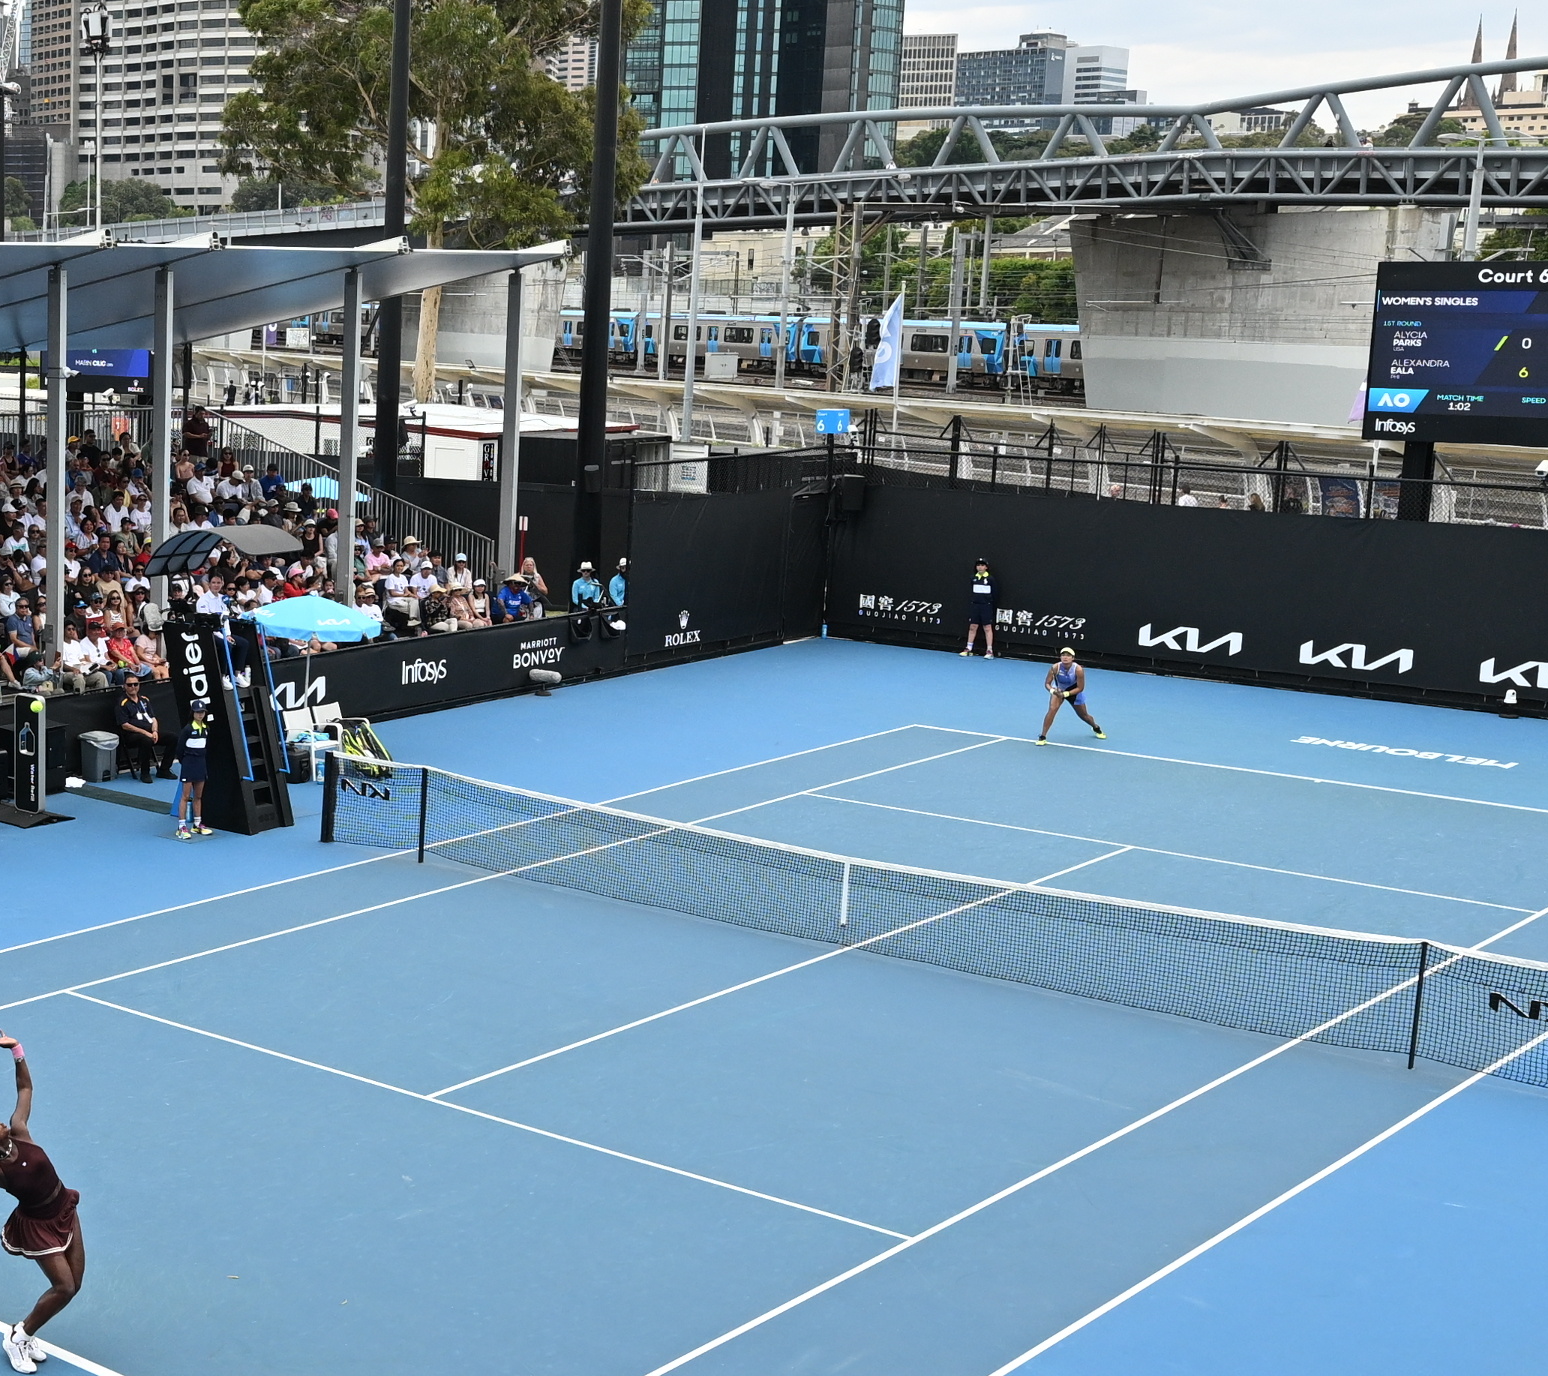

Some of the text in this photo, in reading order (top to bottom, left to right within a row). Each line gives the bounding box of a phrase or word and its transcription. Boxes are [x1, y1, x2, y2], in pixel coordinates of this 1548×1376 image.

[1478, 268, 1533, 283] Court
[1382, 296, 1479, 306] WOMEN'S SINGLES
[1393, 331, 1428, 339] ALYCIA
[1393, 339, 1422, 347] PARKS
[1521, 338, 1532, 349] 0
[1391, 359, 1450, 368] ALEXANDRA
[1390, 367, 1414, 375] EALA
[1518, 367, 1529, 378] 6
[1377, 392, 1410, 407] AO
[1436, 394, 1464, 402] MATCH
[1448, 402, 1471, 411] 1:02
[817, 419, 825, 431] 6
[1375, 418, 1416, 435] Infosys
[895, 598, 943, 616] 1573
[858, 609, 942, 625] GUOJIAO 1573
[1035, 613, 1088, 632] 1573
[664, 630, 701, 648] ROLEX
[995, 625, 1086, 641] GUOJIAO 1573
[520, 637, 557, 650] MARRIOTT
[513, 646, 564, 670] BONVOY
[401, 657, 447, 686] Infosys
[1289, 735, 1519, 769] MELBOURNE
